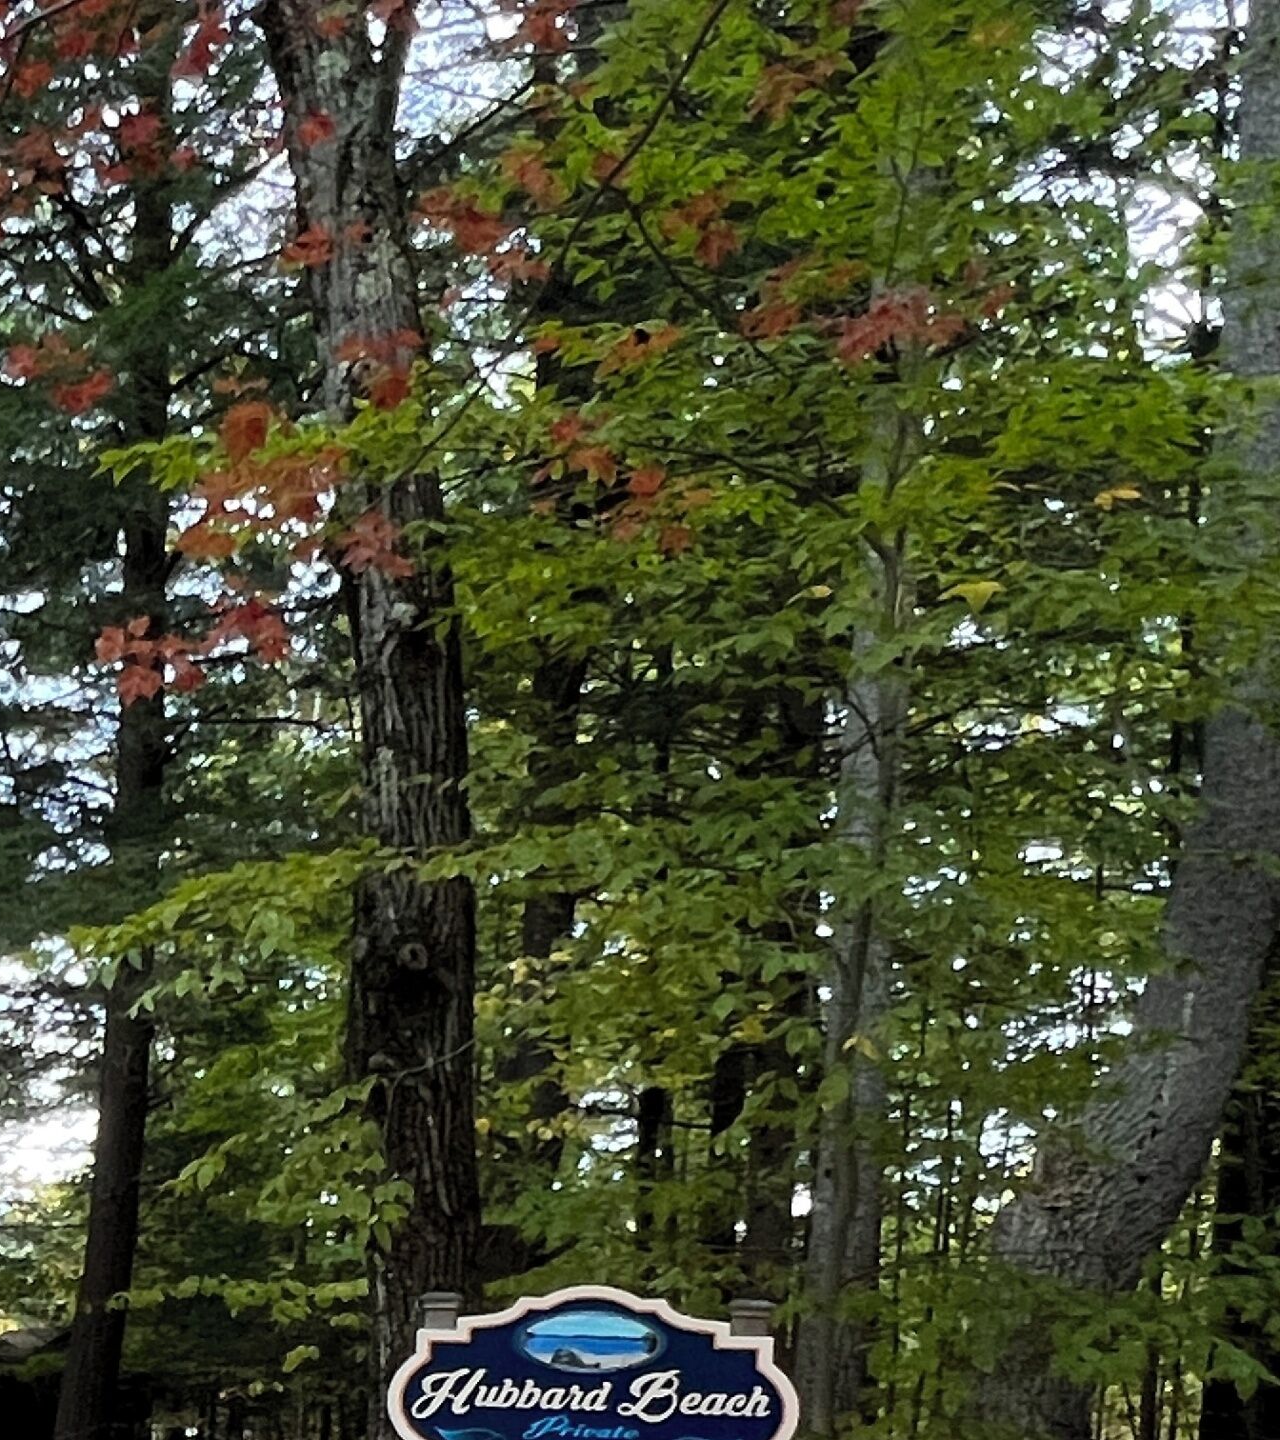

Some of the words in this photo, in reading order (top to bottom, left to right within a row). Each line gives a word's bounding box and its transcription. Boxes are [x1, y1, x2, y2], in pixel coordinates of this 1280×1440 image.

[411, 1368, 613, 1420] Hubbard
[618, 1369, 771, 1423] Beach
[523, 1416, 639, 1440] Private
